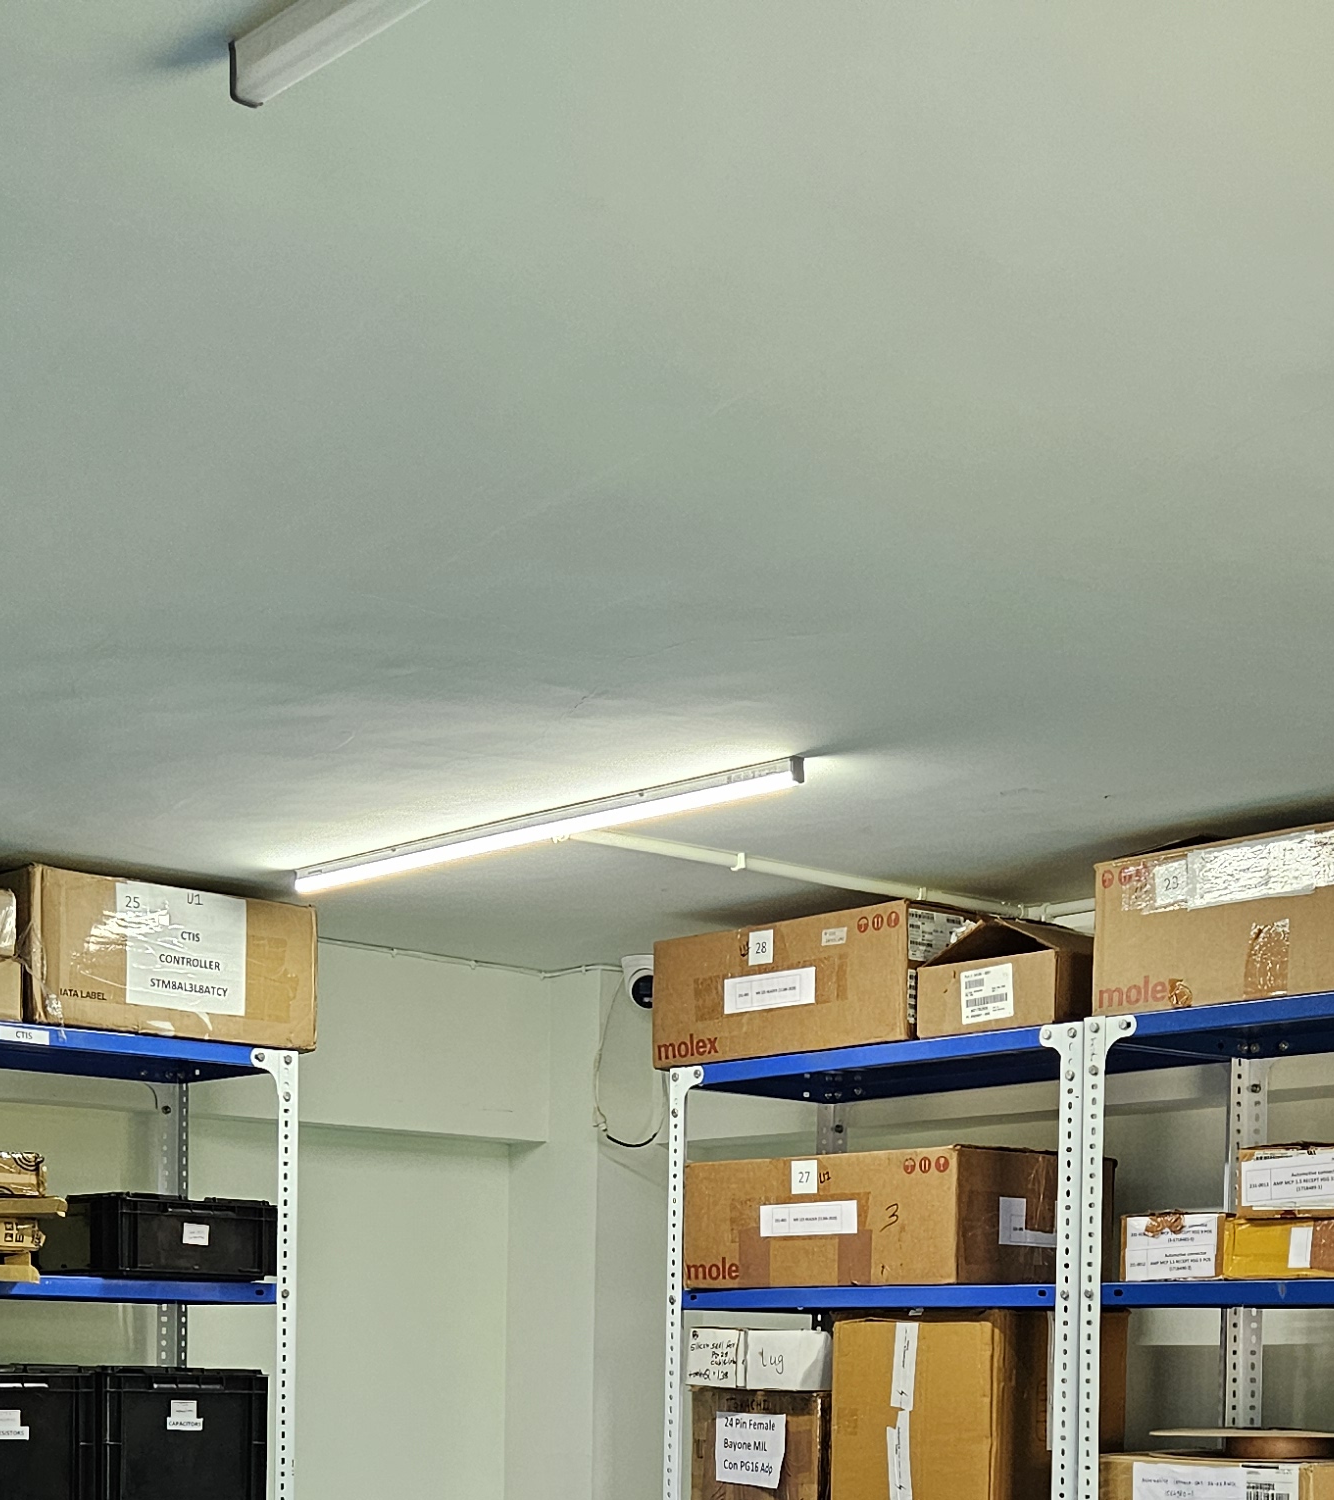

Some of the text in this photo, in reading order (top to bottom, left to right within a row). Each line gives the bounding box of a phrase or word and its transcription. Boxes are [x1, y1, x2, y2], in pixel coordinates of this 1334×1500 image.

[125, 895, 140, 909] 25
[181, 930, 200, 942] CTIS
[755, 941, 767, 954] 28
[159, 953, 221, 972] CONTROLLER
[1098, 976, 1167, 1008] mole
[15, 1029, 33, 1040] CTIS
[657, 1034, 719, 1061] molex
[798, 1171, 810, 1183] 27
[880, 1202, 899, 1232] 3
[686, 1257, 740, 1281] mole
[724, 1417, 775, 1432] 24 Pin Female
[724, 1438, 752, 1452] Bayone
[724, 1459, 738, 1471] Con
[740, 1460, 759, 1473] PG16
